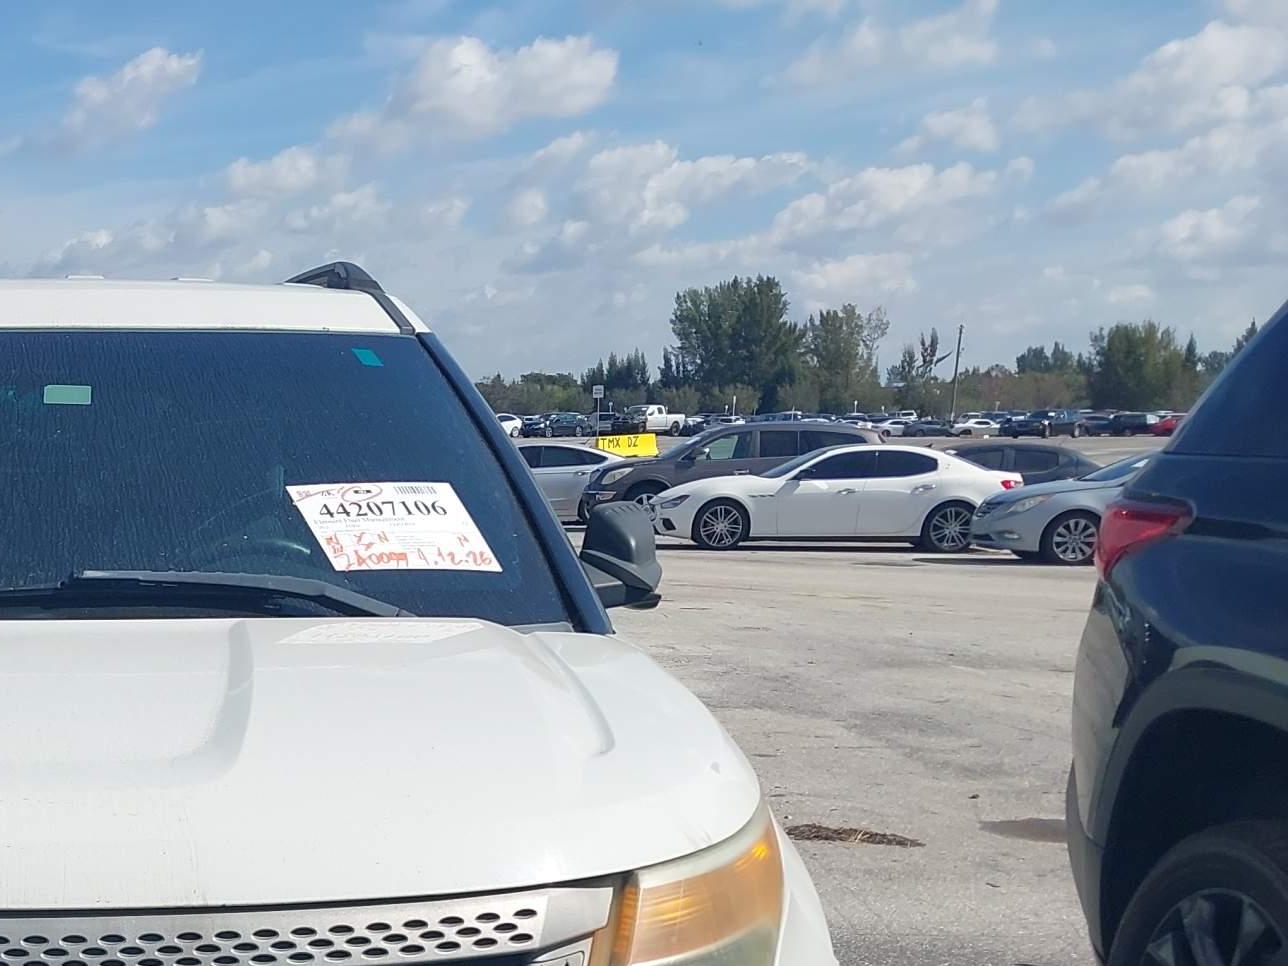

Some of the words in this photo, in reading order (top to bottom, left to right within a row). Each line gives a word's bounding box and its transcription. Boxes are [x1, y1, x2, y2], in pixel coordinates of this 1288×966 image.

[600, 437, 621, 451] TMX
[627, 436, 640, 448] DZ
[319, 500, 448, 518] 44207106
